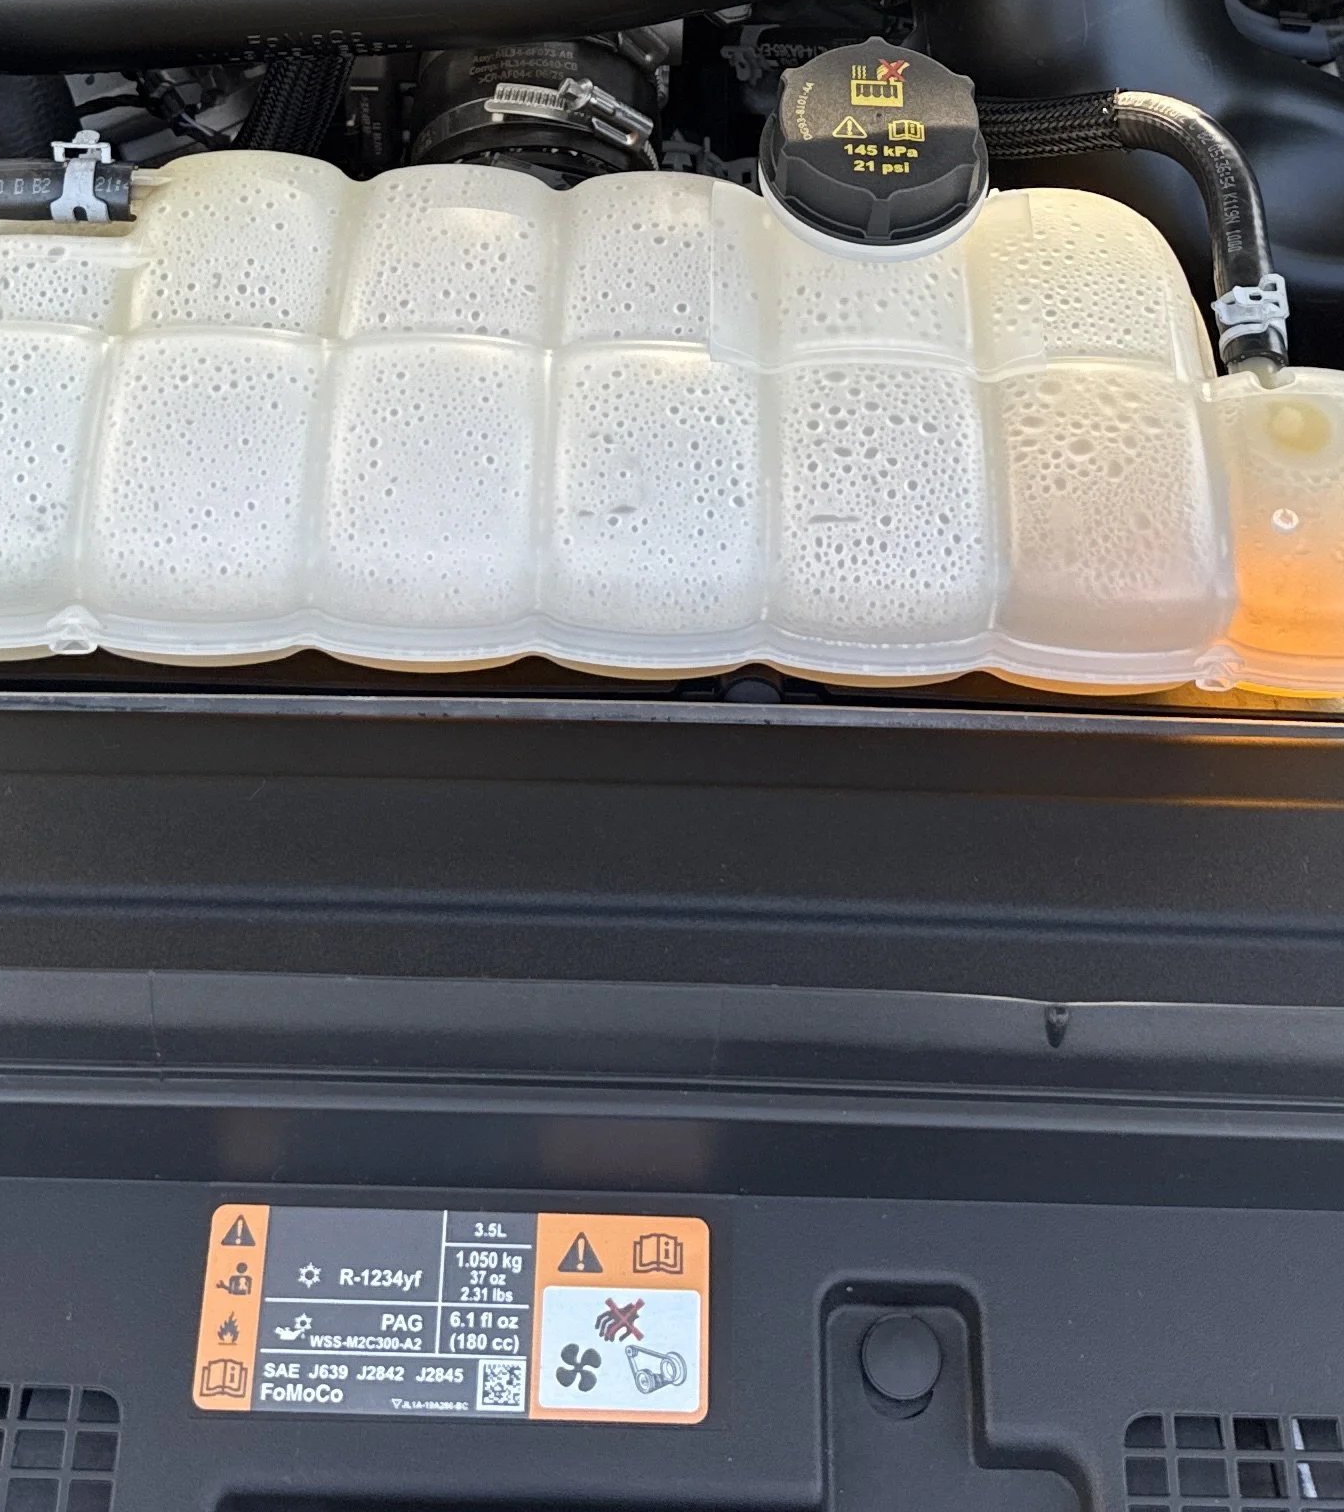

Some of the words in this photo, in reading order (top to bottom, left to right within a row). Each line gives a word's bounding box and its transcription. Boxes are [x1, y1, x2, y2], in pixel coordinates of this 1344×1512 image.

[843, 144, 878, 157] 145
[883, 145, 919, 158] kPa
[853, 160, 876, 172] 21
[882, 161, 910, 175] psi
[474, 1223, 507, 1239] 3.5L
[456, 1251, 497, 1270] 1.050
[502, 1254, 522, 1273] kg
[339, 1269, 422, 1289] R-1234yf
[470, 1271, 487, 1286] 37
[490, 1274, 506, 1286] oz
[460, 1288, 489, 1302] 2.31
[492, 1288, 513, 1303] lbs
[382, 1314, 423, 1333] PAG
[450, 1312, 478, 1331] 6.1
[480, 1312, 494, 1331] fl
[498, 1317, 519, 1331] oz
[310, 1336, 422, 1352] WSS-M2C300-A2
[450, 1334, 490, 1354] (180
[492, 1335, 519, 1354] cc)
[264, 1363, 299, 1379] SAE
[309, 1363, 348, 1380] J639
[356, 1364, 404, 1382] J2842
[416, 1367, 464, 1385] J2845
[260, 1382, 343, 1403] FoMoCo
